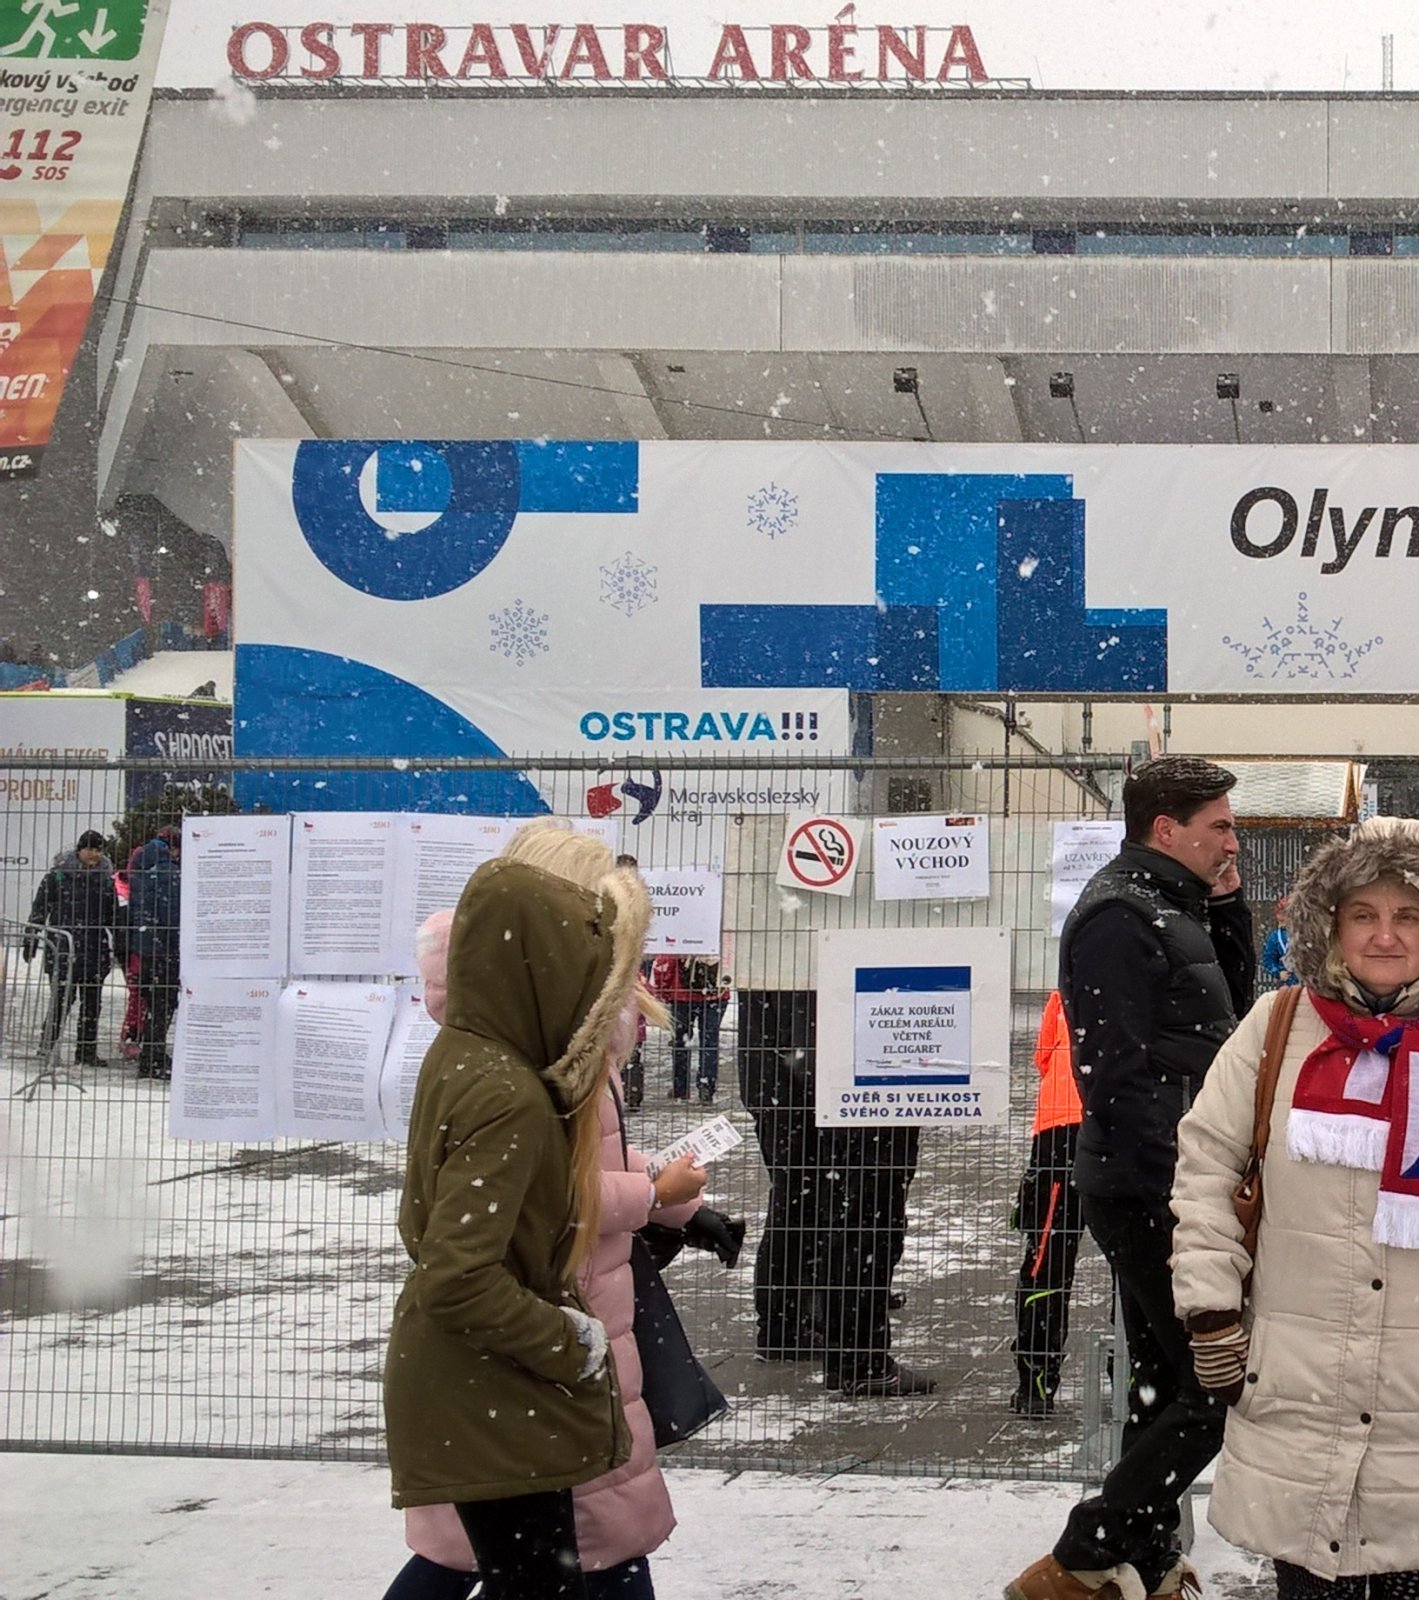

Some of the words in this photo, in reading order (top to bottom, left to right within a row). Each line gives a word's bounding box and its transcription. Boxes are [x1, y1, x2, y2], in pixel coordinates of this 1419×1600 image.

[226, 21, 669, 80] OSTRAVAR
[708, 4, 989, 82] ARÉNA
[83, 97, 129, 116] exit
[2, 128, 82, 161] 112
[32, 165, 69, 181] SOS
[579, 711, 818, 741] OSTRAVA!!!
[671, 806, 702, 826] kraj
[889, 832, 975, 852] NOUZOVÝ
[896, 853, 970, 870] VÝCHOD
[870, 1005, 904, 1016] ZÁKAZ
[908, 1004, 955, 1016] KOUŘENÍ
[869, 1020, 877, 1029] V
[878, 1018, 911, 1029] CELÉM
[883, 1044, 942, 1054] EL.CIGARET
[841, 1091, 881, 1103] OVĚŘ
[886, 1093, 900, 1103] SI
[906, 1092, 981, 1103] VELIKOST
[840, 1106, 890, 1118] SVÉHO
[895, 1107, 982, 1117] ZAVAZADLA
